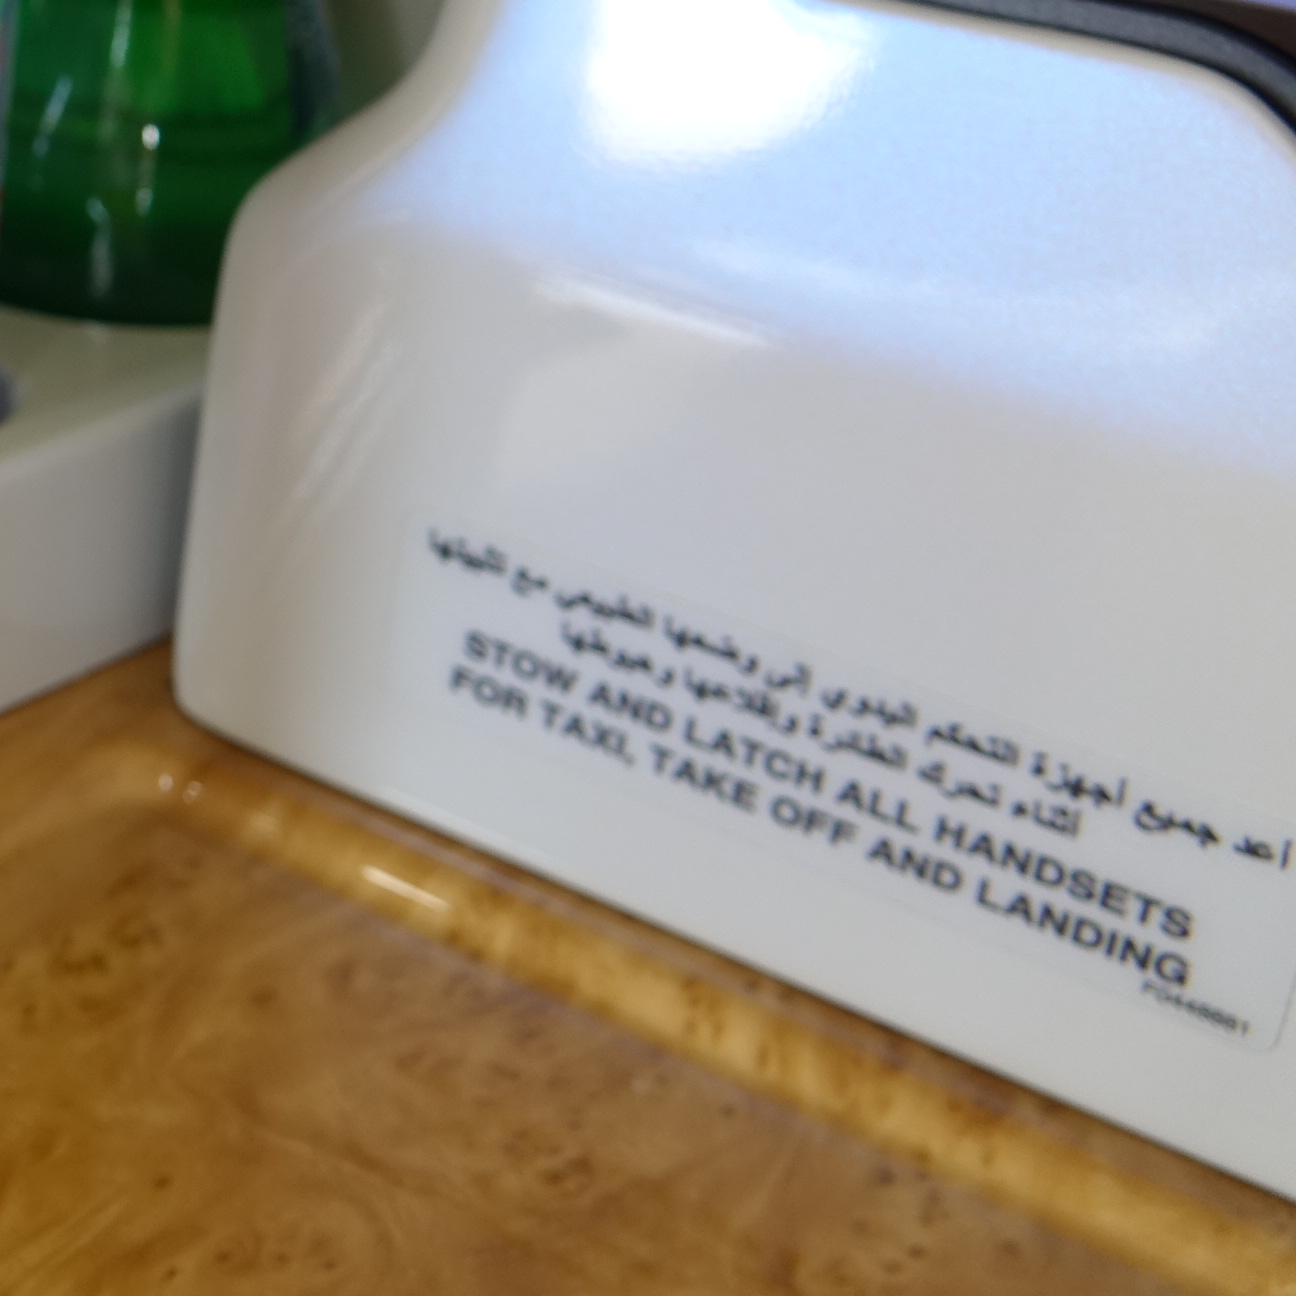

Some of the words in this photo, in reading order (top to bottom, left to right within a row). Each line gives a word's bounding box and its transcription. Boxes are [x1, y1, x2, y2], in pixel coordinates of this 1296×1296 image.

[448, 662, 529, 721] FOR
[649, 742, 762, 815] TAKE
[769, 794, 859, 847] OFF
[868, 833, 963, 895] AND
[975, 876, 1192, 987] LANDING
[464, 628, 580, 695] STOW
[589, 682, 674, 733] AND
[683, 715, 825, 794] LATCH
[835, 780, 920, 835] ALL
[933, 815, 1195, 940] HANDSETS
